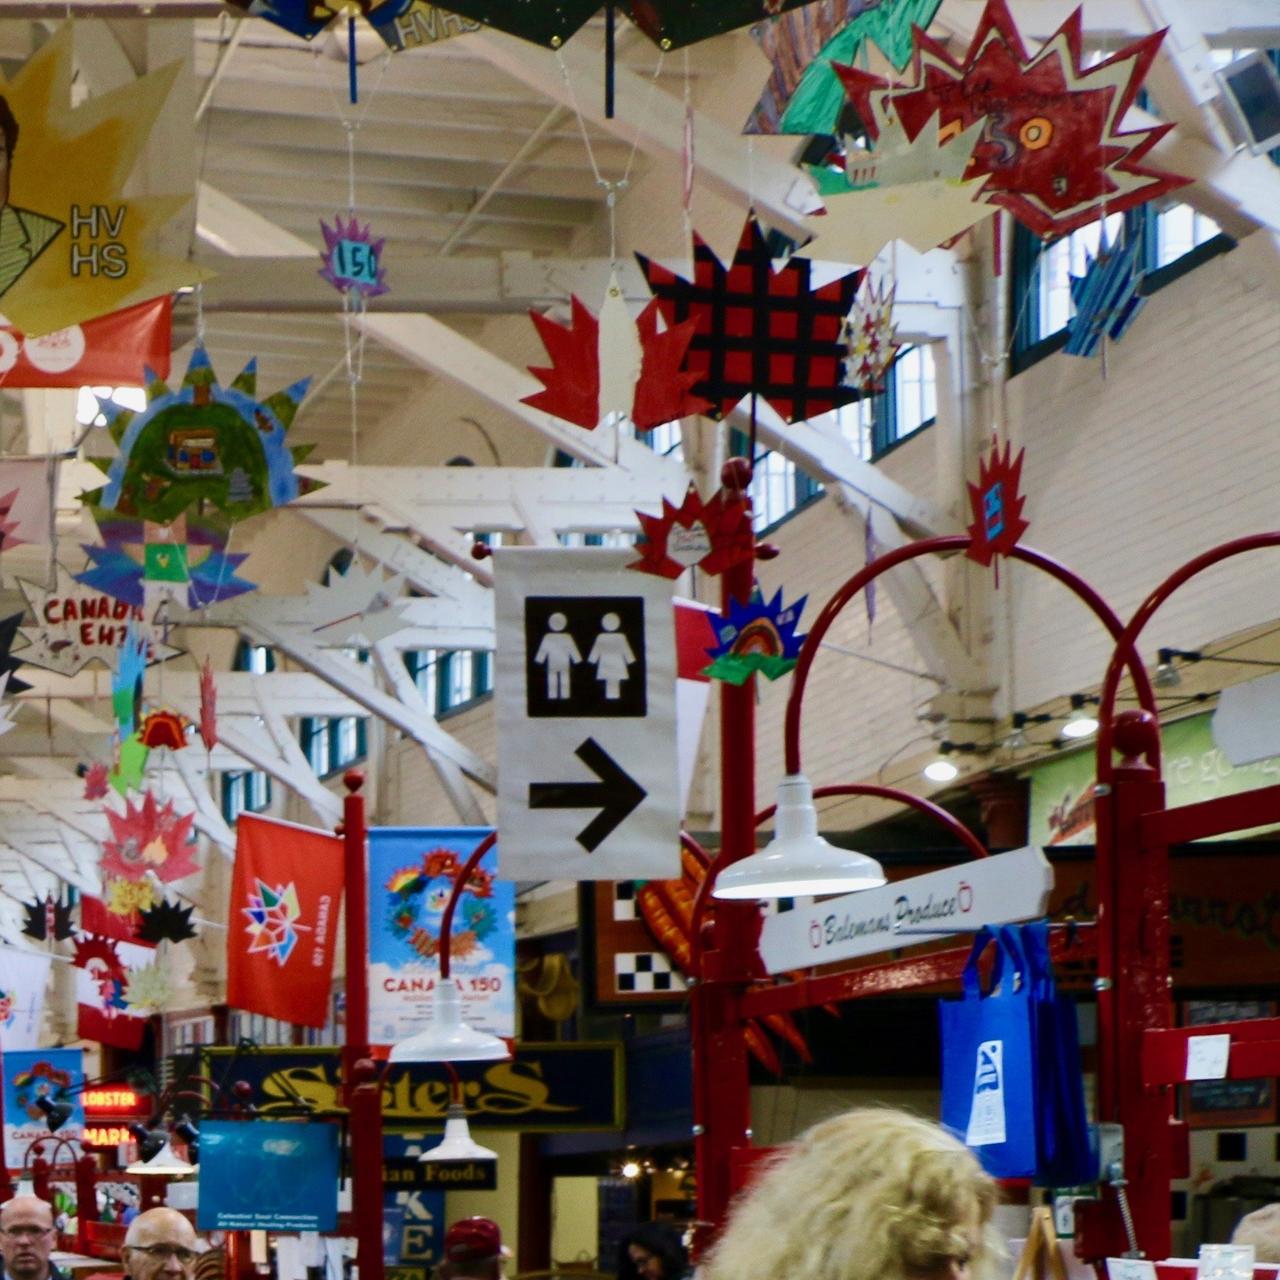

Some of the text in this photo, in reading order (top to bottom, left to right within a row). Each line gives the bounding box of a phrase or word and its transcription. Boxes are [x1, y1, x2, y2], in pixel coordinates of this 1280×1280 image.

[71, 205, 128, 238] HV
[71, 245, 128, 279] HS
[331, 243, 378, 283] 150
[824, 895, 956, 945] Balemans Produce
[383, 977, 501, 993] CANAA 150
[82, 1091, 136, 1106] LOBSTER
[425, 1163, 486, 1181] Foods
